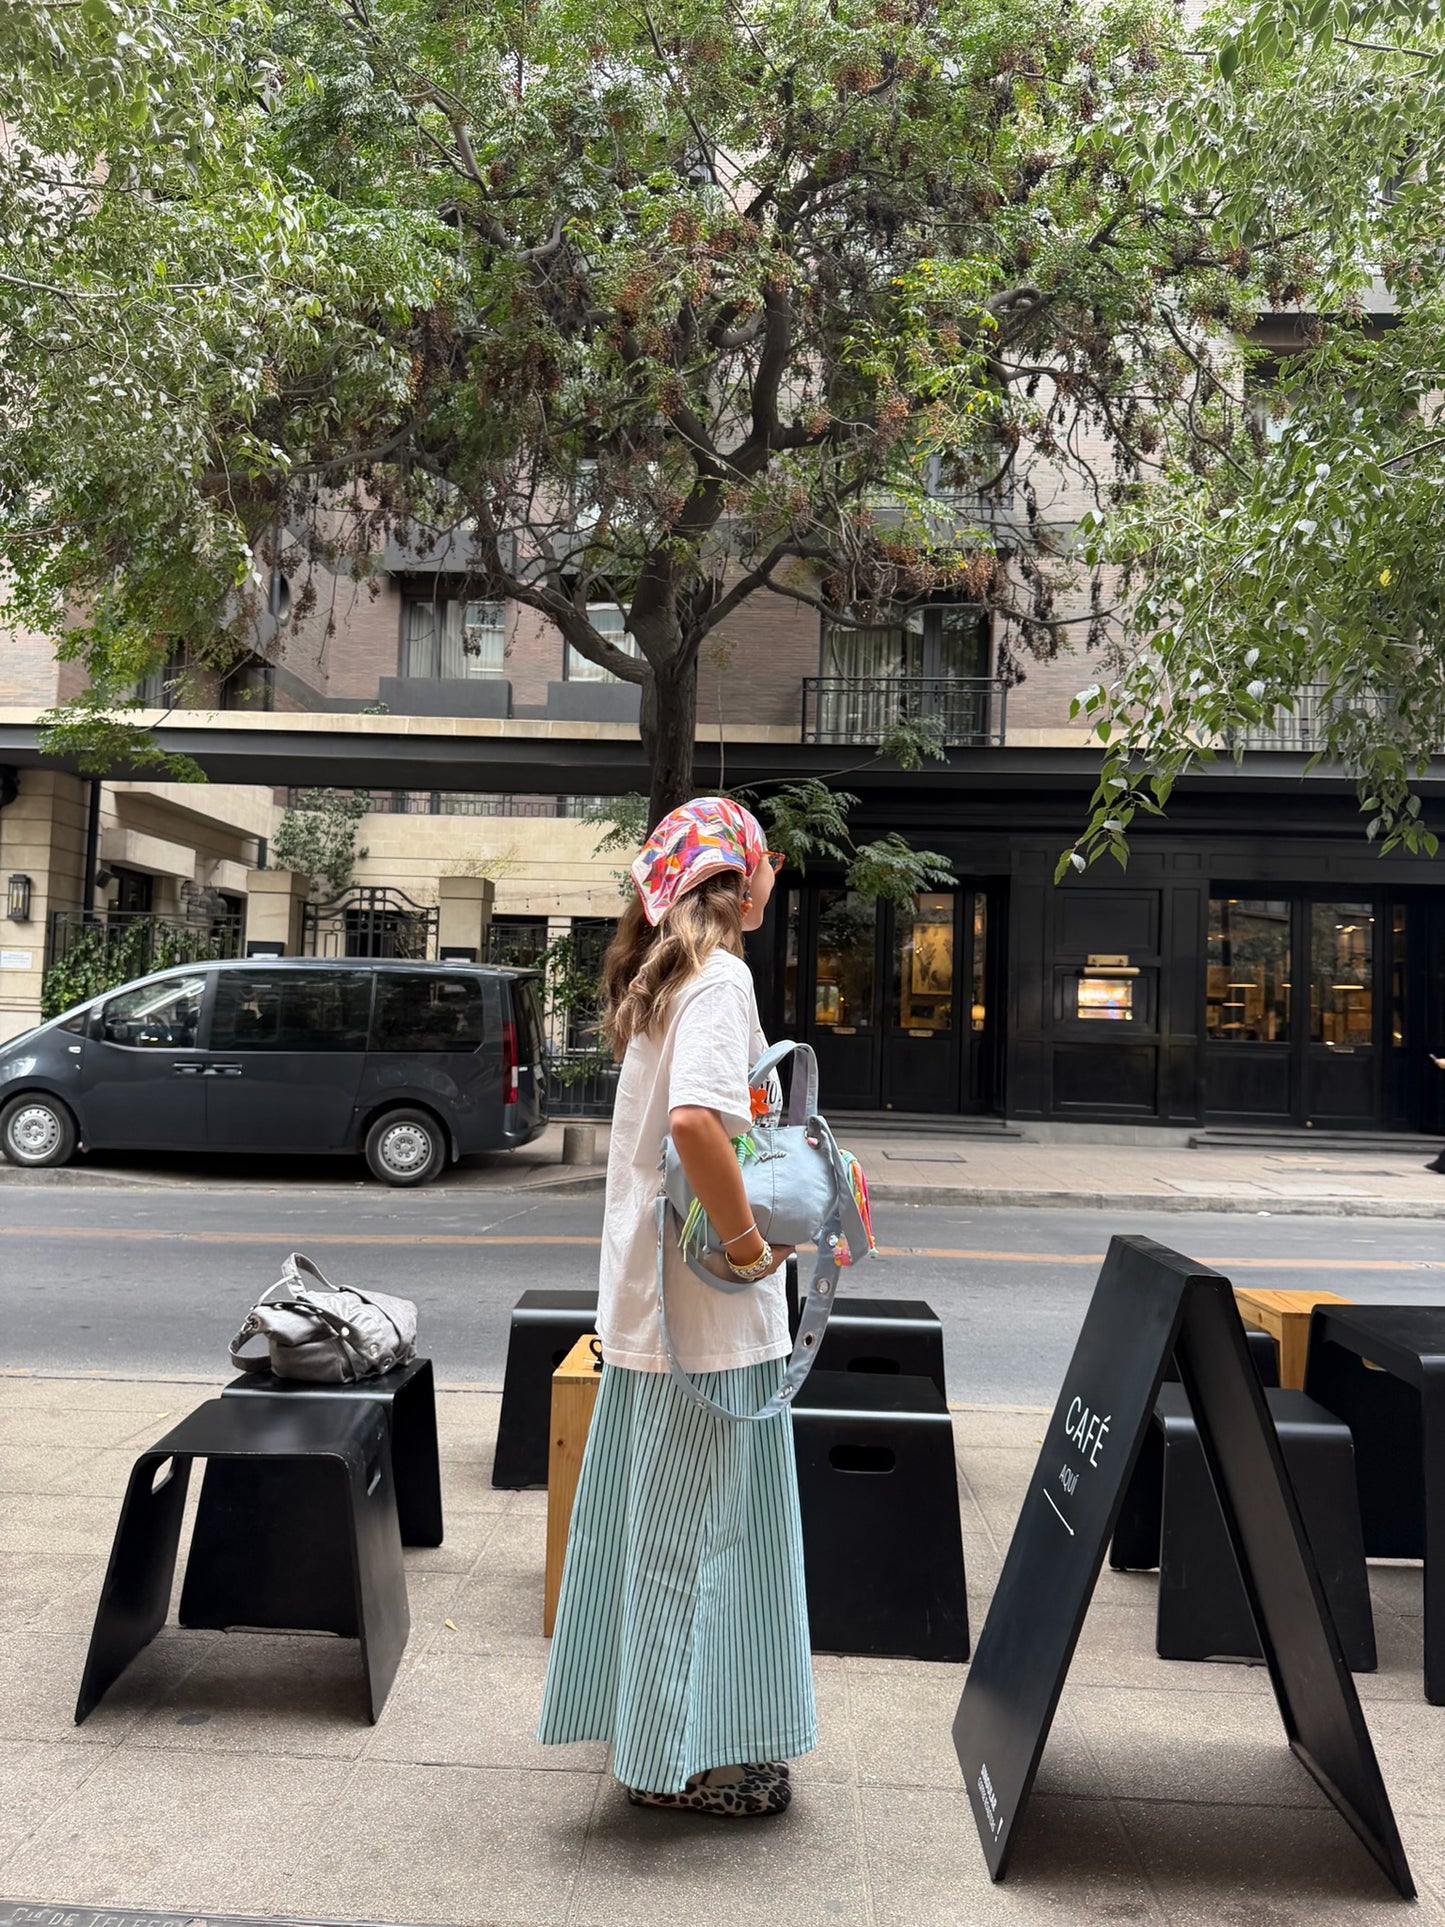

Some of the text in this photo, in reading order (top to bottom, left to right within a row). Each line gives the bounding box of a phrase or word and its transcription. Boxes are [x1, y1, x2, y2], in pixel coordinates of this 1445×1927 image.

[1065, 1395, 1112, 1468] CAFÉ
[1058, 1463, 1080, 1496] AQUÍ
[48, 1912, 79, 1926] DE
